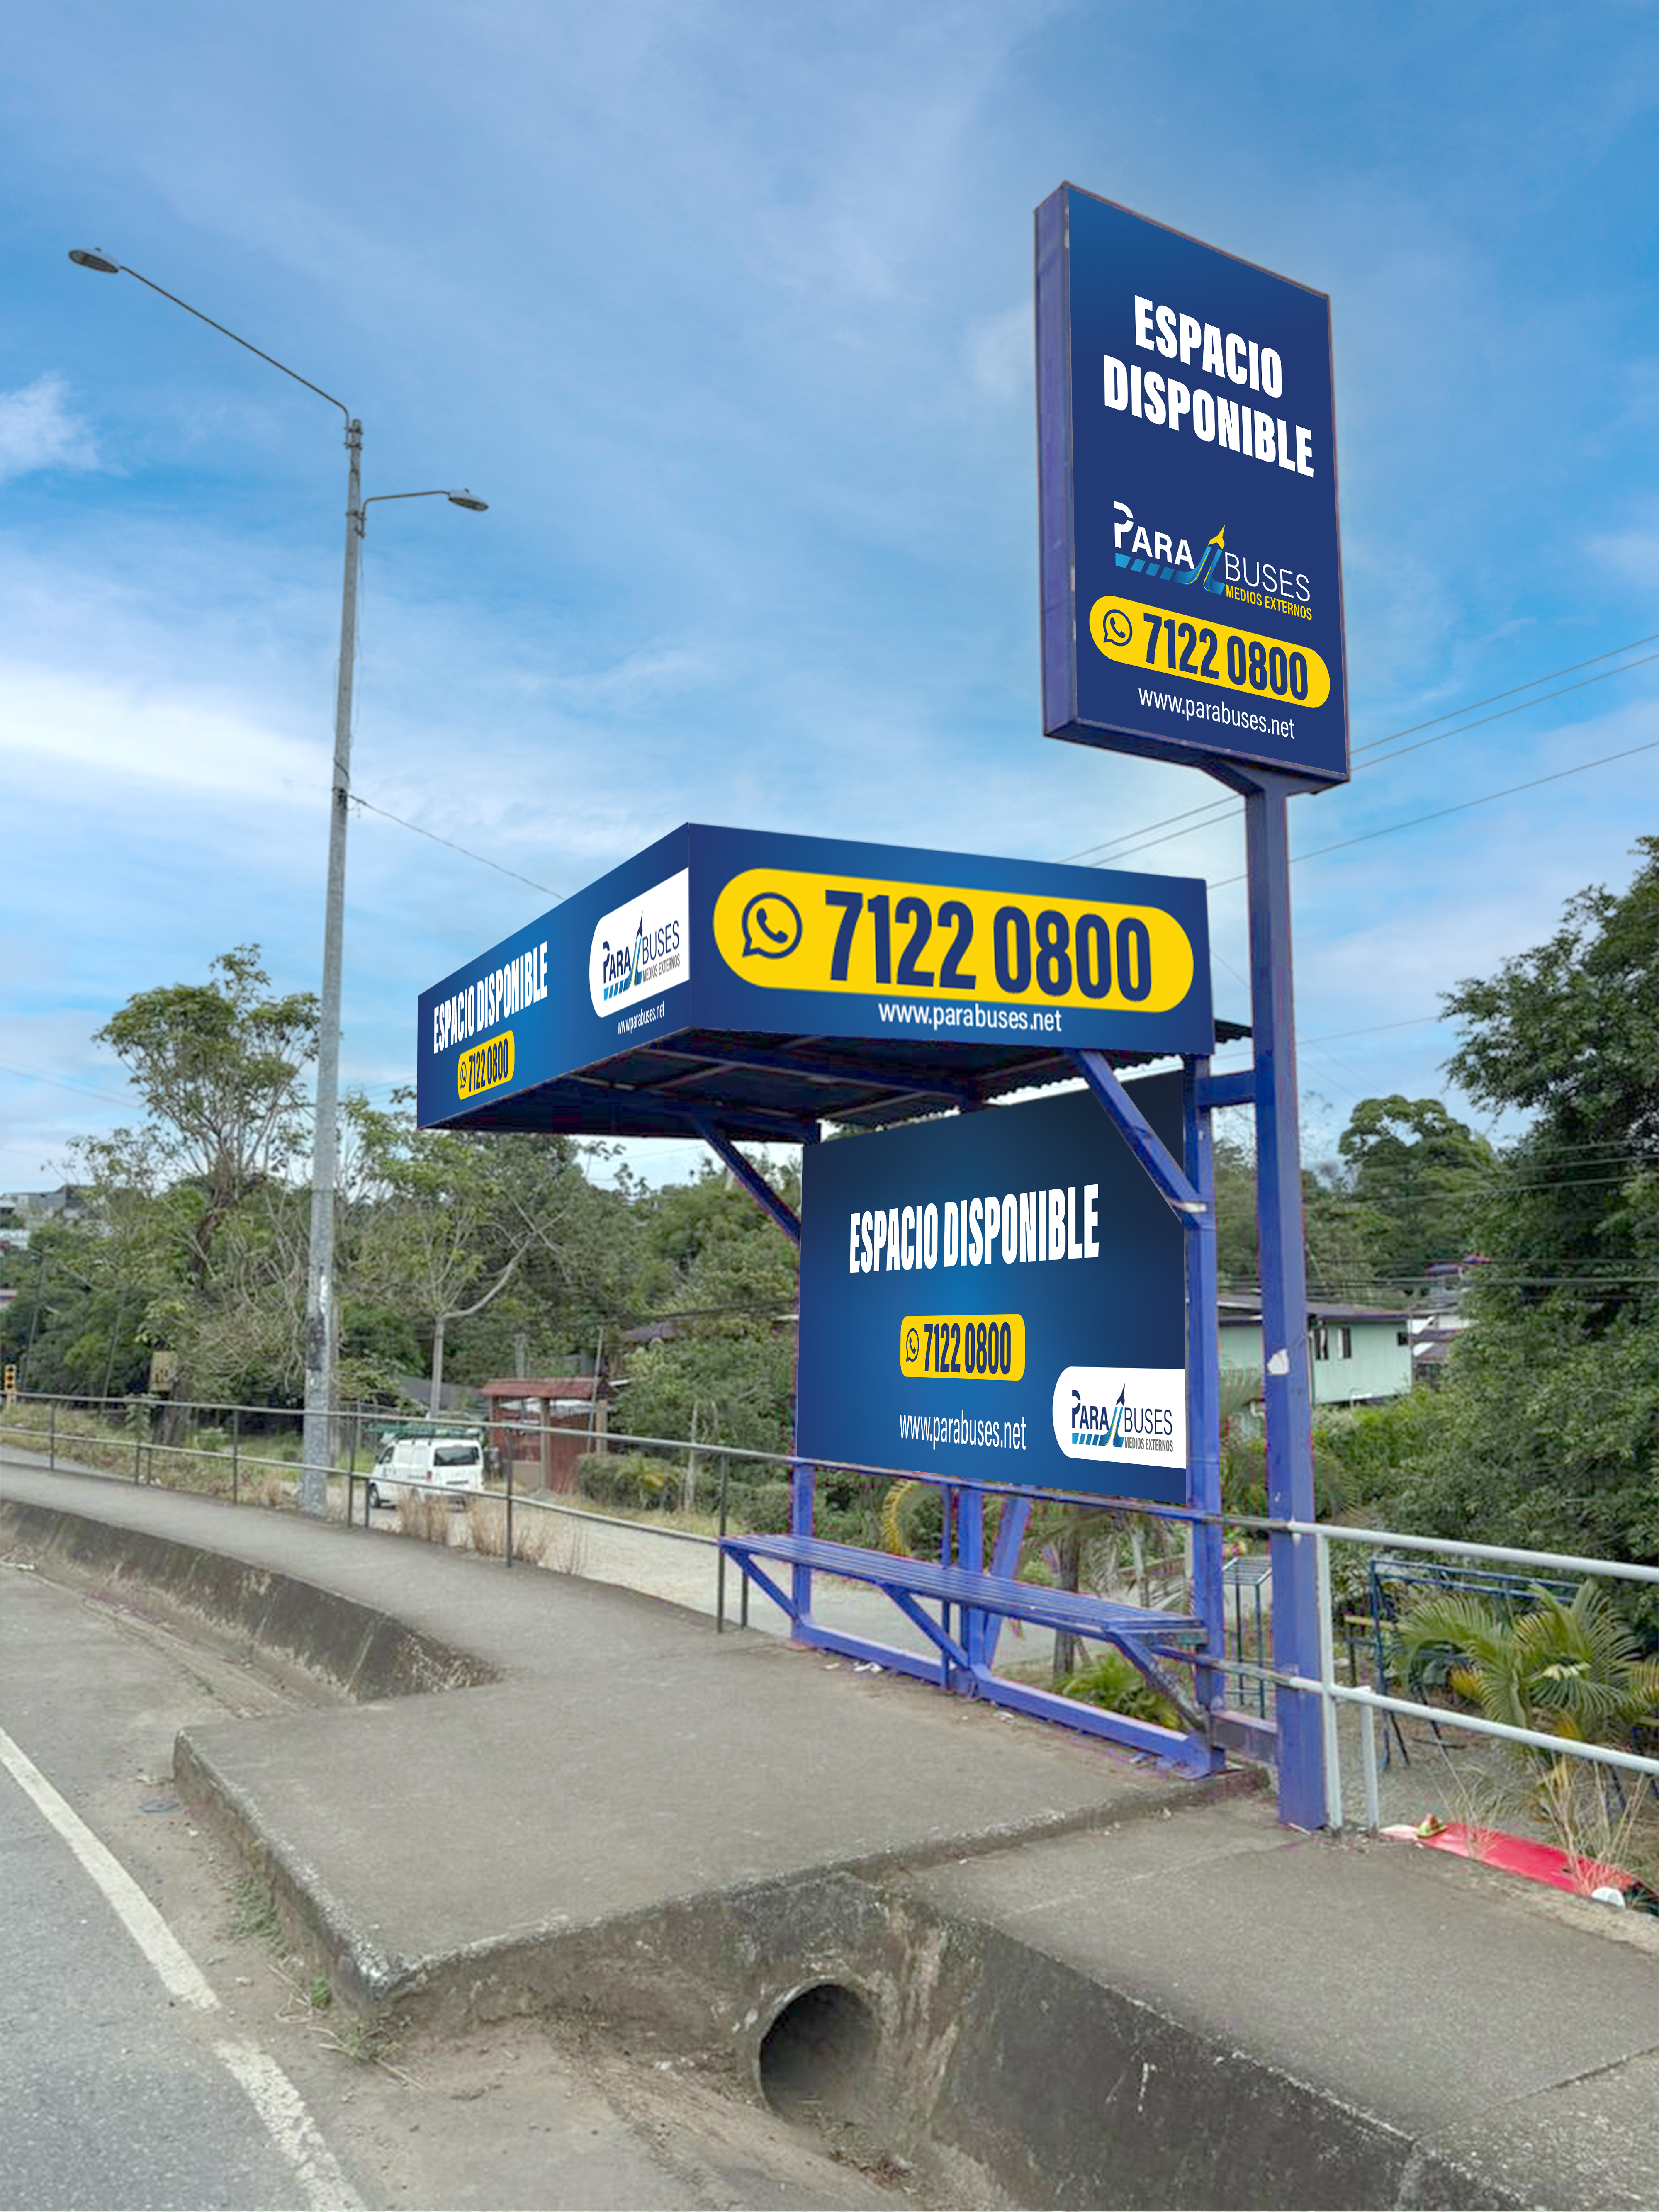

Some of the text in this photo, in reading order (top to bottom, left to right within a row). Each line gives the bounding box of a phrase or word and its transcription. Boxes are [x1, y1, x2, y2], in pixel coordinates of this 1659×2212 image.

[1135, 294, 1282, 398] ESPACIO
[1103, 353, 1314, 478] DISPONIBLE
[1226, 585, 1312, 620] MEDIOS EXTERNOS
[1143, 613, 1308, 700] 7122 0800
[1138, 688, 1295, 739] www.parabuses.net
[642, 953, 680, 983] MEDIOS EXTERNOS
[825, 890, 1151, 1001] 7122 0800
[434, 941, 547, 1054] ESPACIO DISPONIBLE
[618, 1001, 664, 1035] www.parabuses.net
[878, 1003, 1062, 1032] www.parabuses.net
[469, 1038, 508, 1092] 7122 0800
[850, 1184, 1100, 1273] ESPACIO DISPONIBLE
[924, 1322, 1011, 1375] 7122 0800
[900, 1410, 1026, 1450] www.parabuses.net
[1124, 1437, 1173, 1452] MEDIOS EXTERNOS
